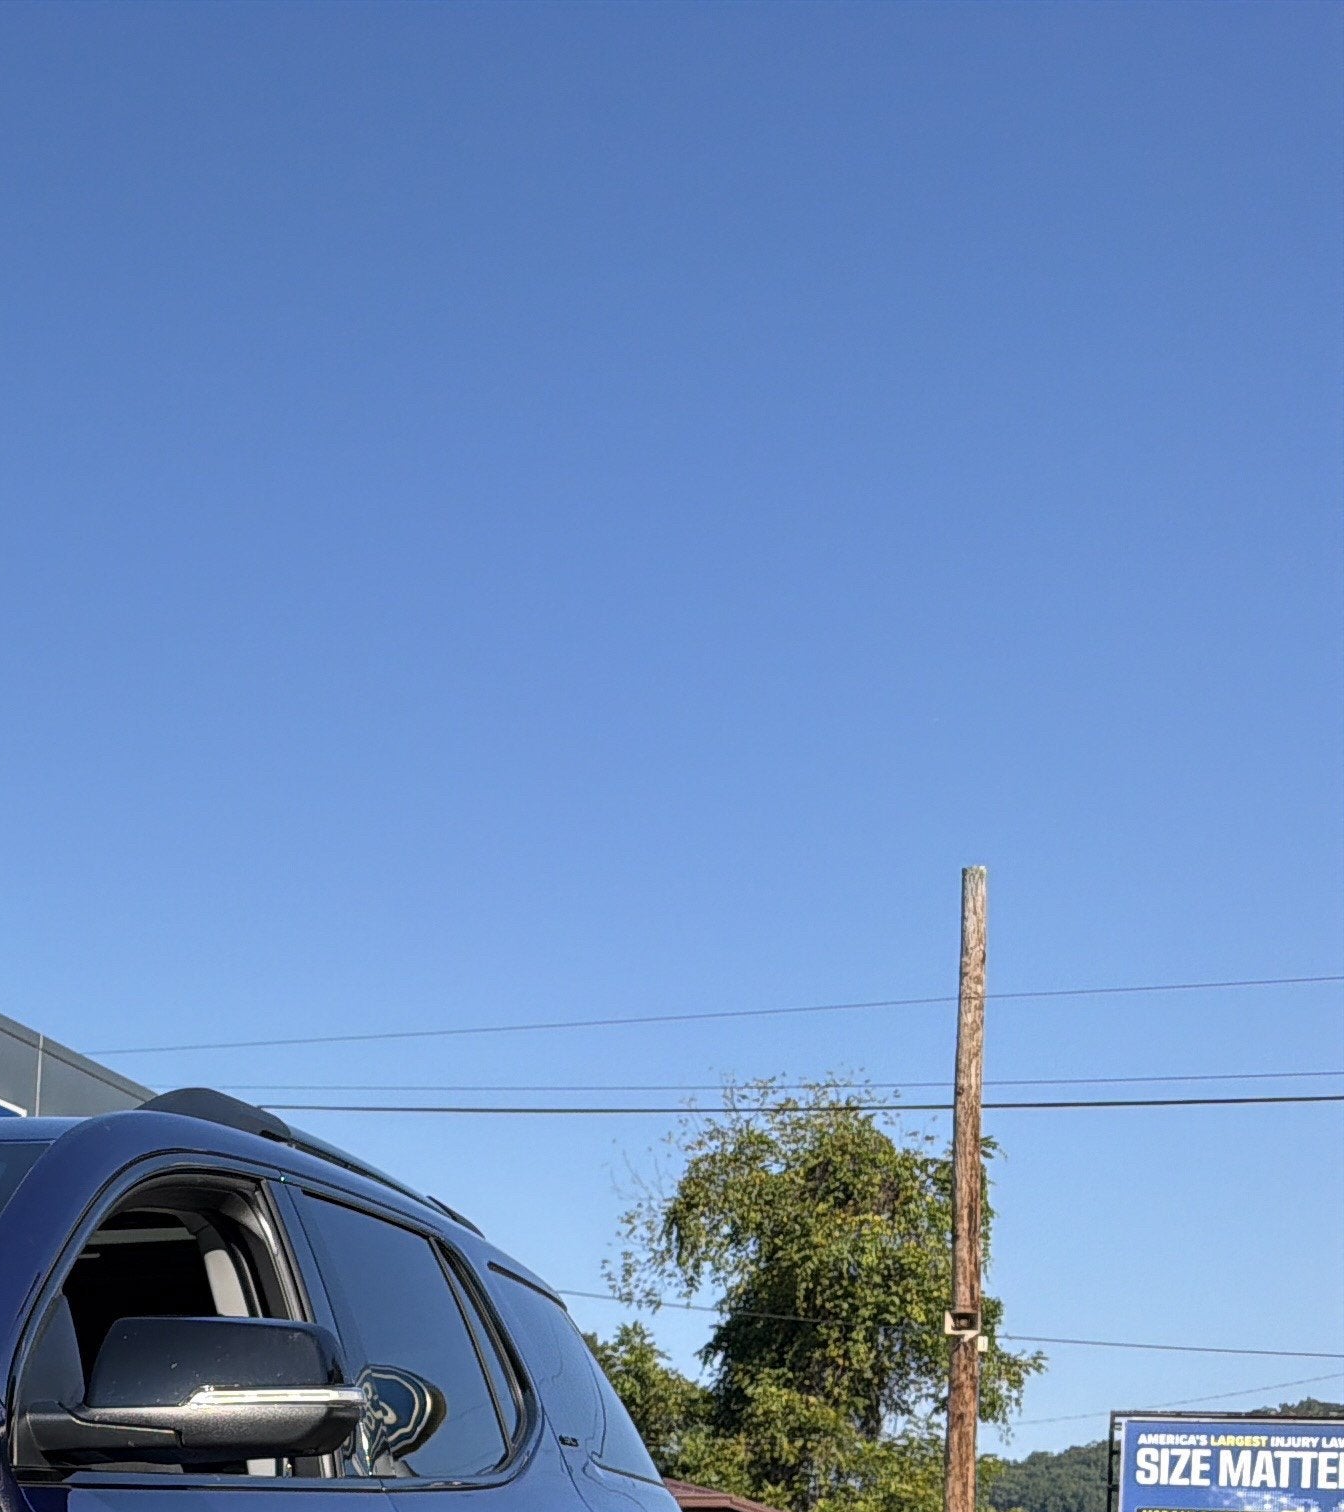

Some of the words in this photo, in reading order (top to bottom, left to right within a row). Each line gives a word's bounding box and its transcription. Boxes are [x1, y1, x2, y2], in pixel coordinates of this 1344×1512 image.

[1137, 1433, 1208, 1446] AMERICA'S
[1210, 1435, 1268, 1447] LARGEST
[1270, 1436, 1321, 1449] INJURY
[1135, 1448, 1212, 1487] SIZE
[1218, 1449, 1344, 1490] MATTE
